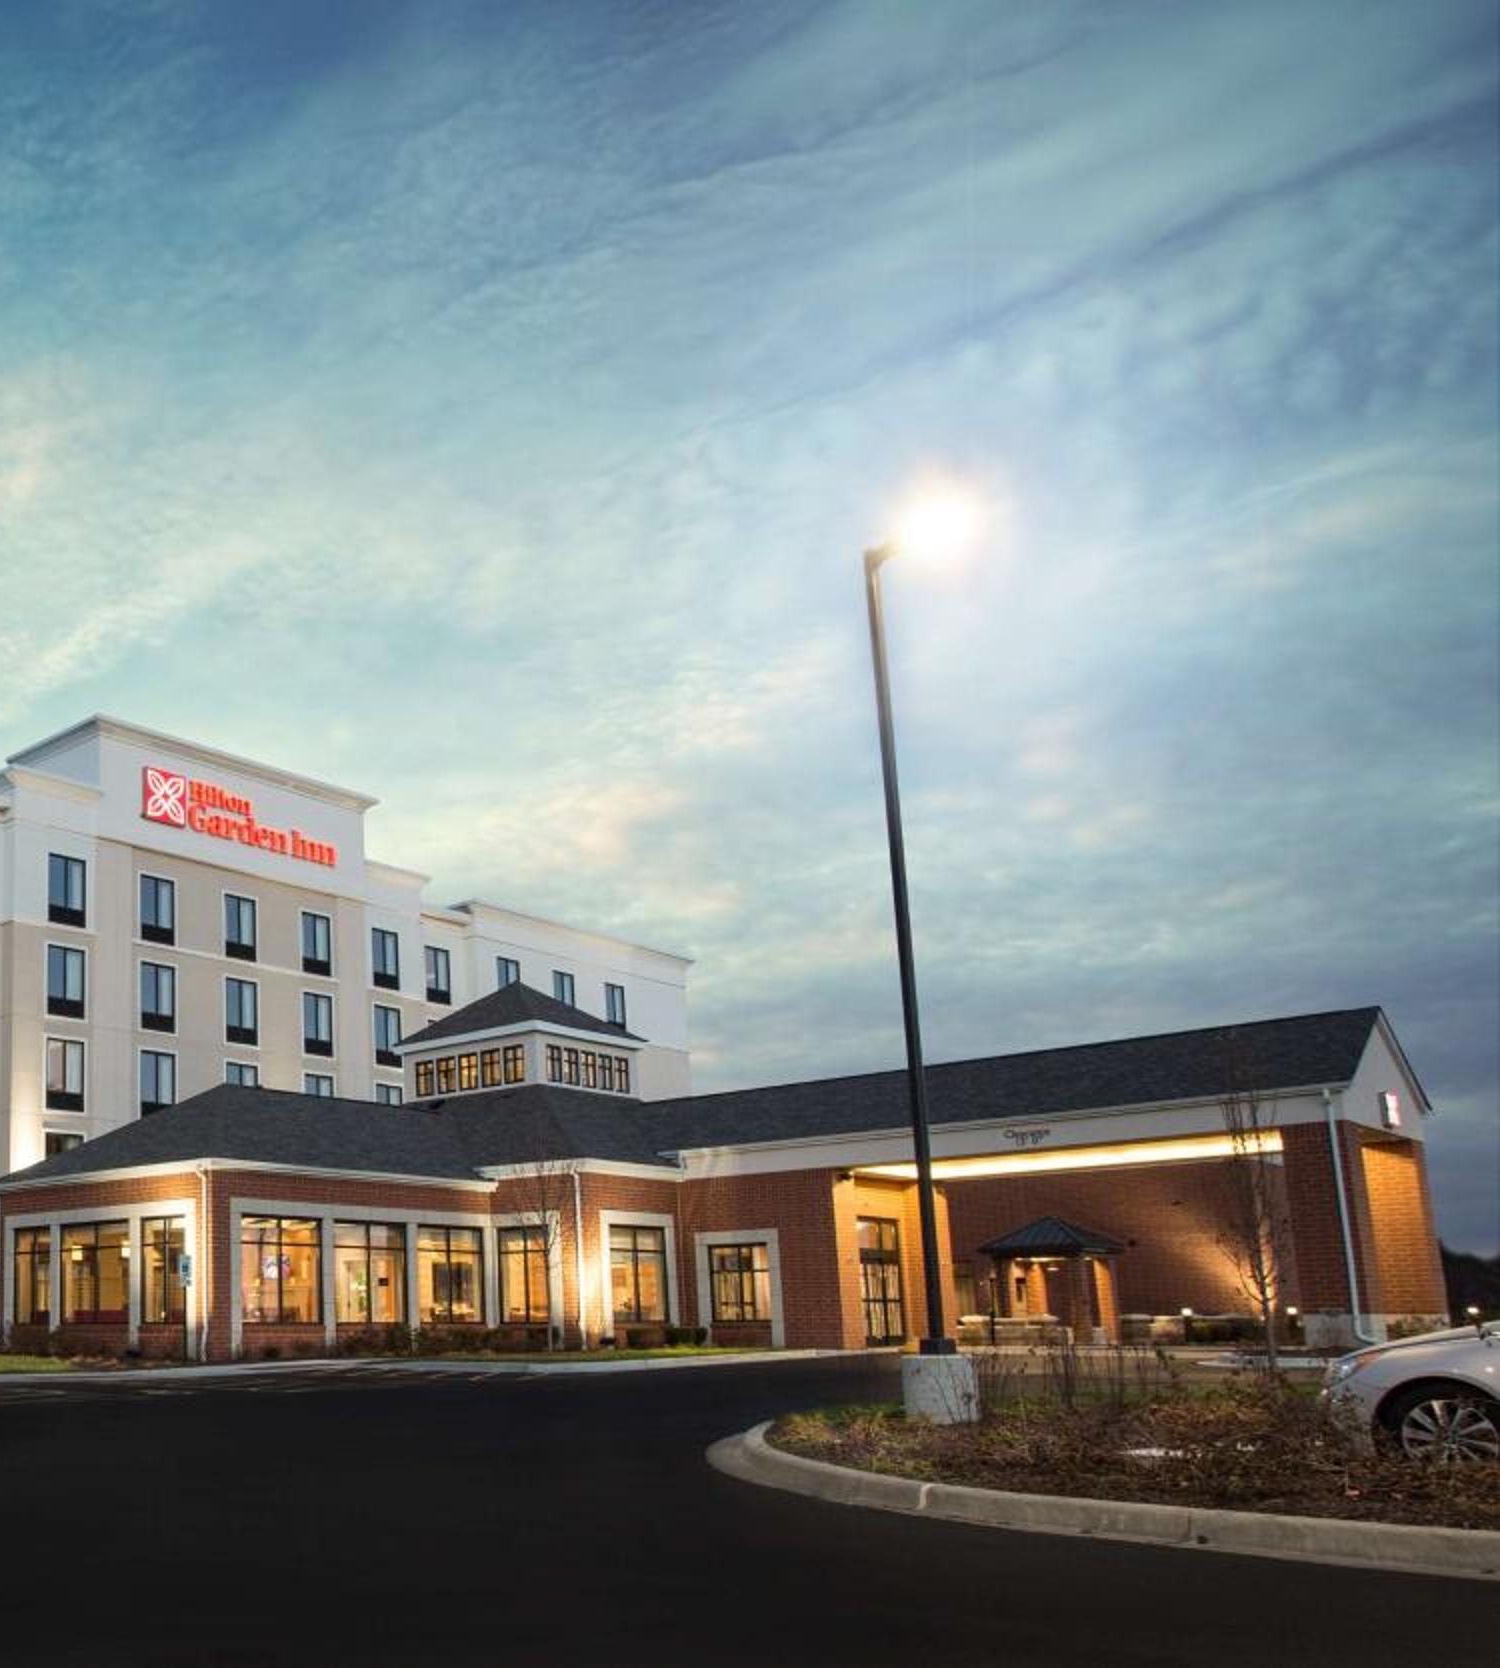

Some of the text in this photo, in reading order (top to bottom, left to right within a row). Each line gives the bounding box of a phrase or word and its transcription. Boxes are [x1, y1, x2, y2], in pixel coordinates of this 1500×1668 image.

[189, 780, 253, 816] Hilton
[188, 803, 337, 866] Garden Inn
